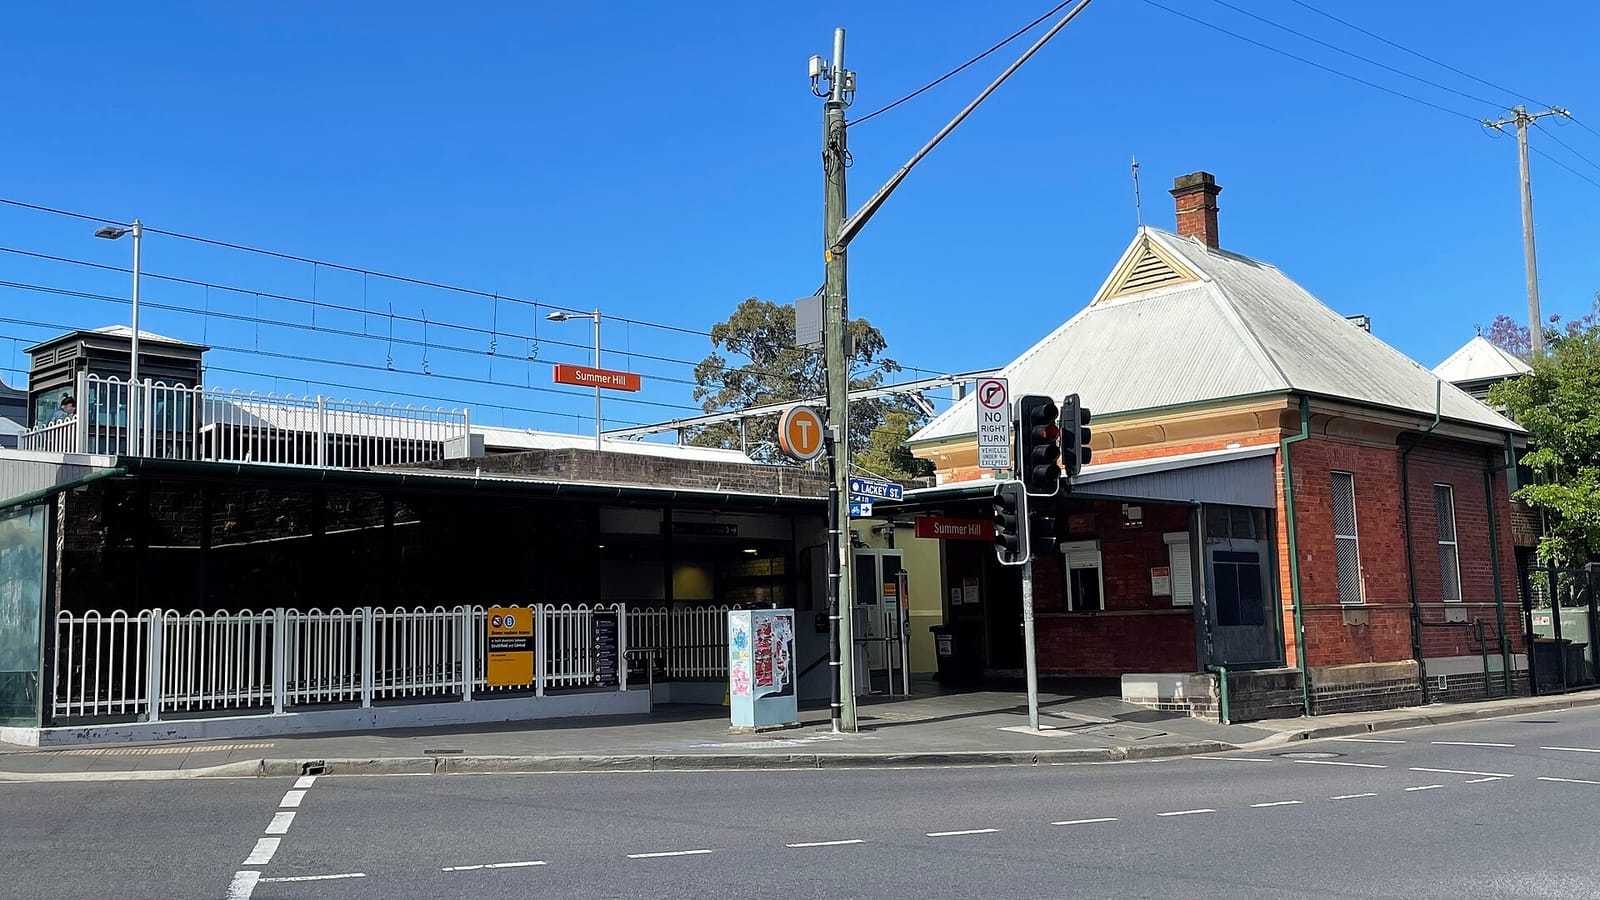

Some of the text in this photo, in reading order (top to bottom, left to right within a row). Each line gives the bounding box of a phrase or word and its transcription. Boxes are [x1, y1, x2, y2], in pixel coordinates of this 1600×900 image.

[575, 370, 626, 385] Summer Hill
[985, 412, 1002, 422] NO
[796, 420, 812, 449] T
[981, 425, 1006, 433] RIGHT
[982, 434, 1006, 442] TURN
[861, 483, 887, 497] LACKEY
[934, 522, 981, 536] Summer Hill
[506, 618, 512, 626] B
